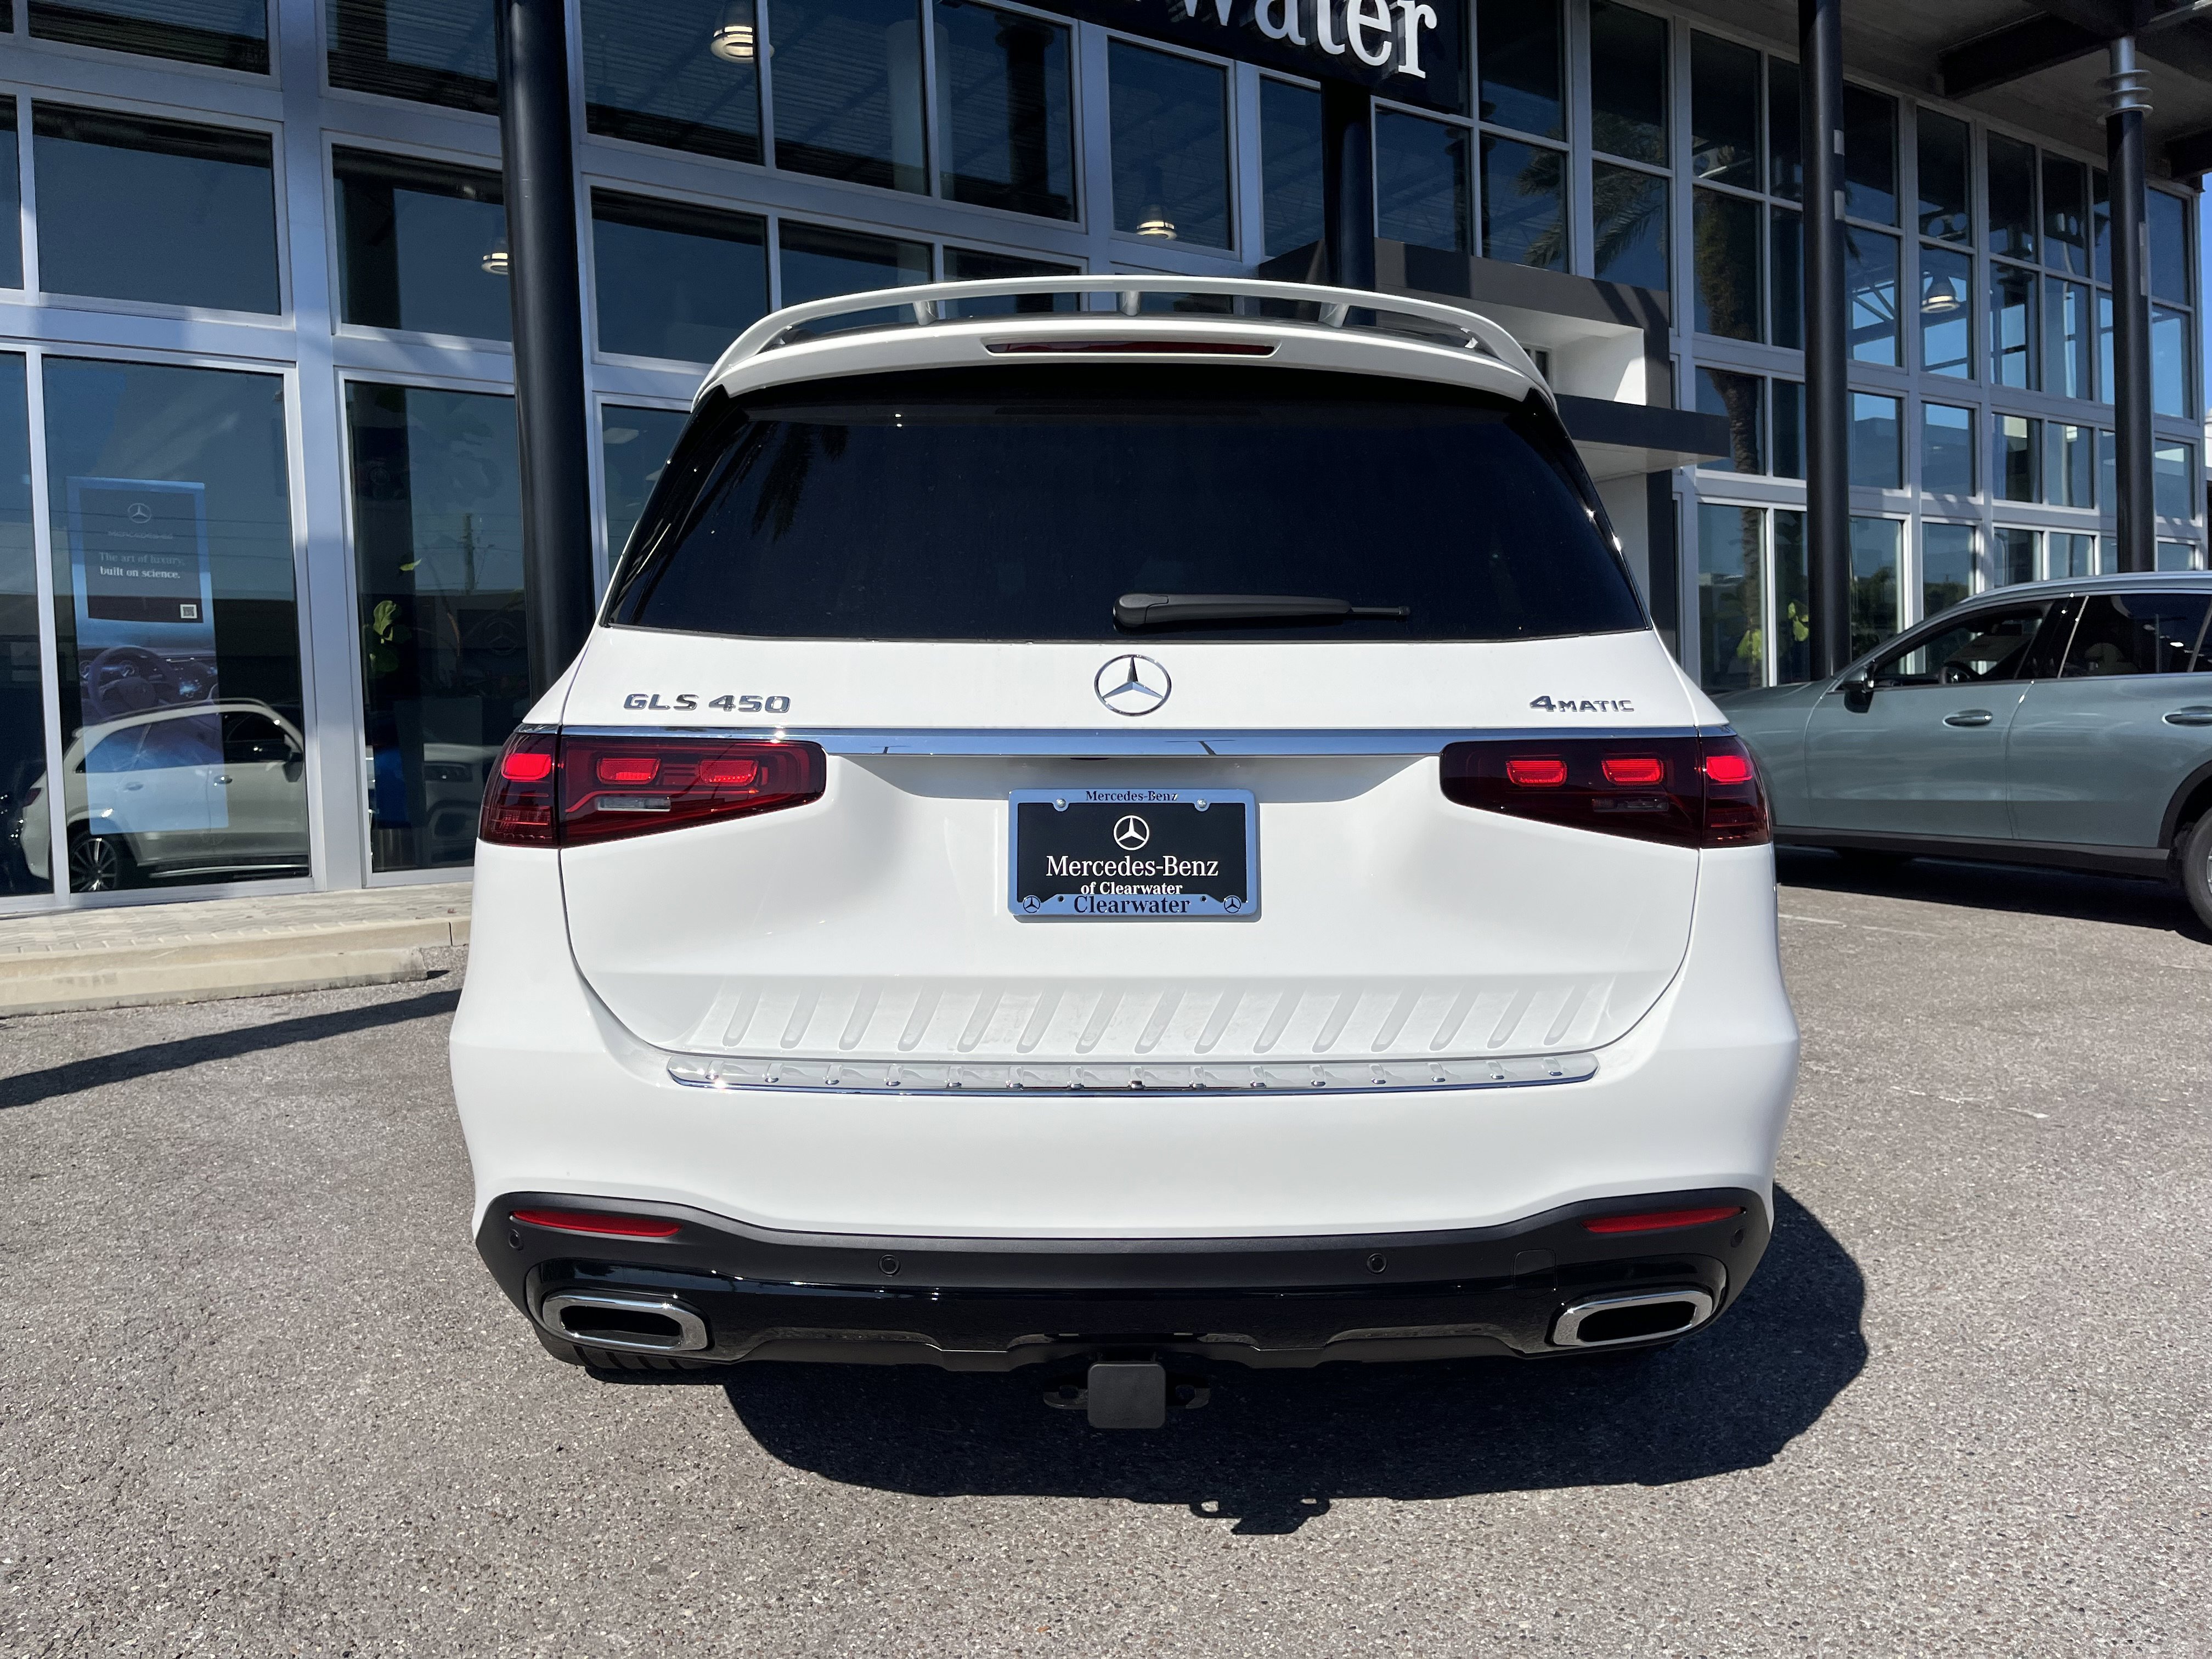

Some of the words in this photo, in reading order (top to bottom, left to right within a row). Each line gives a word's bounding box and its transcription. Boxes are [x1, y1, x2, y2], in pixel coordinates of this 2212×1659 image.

[99, 551, 117, 562] The
[121, 555, 136, 563] art
[138, 554, 148, 563] of
[100, 566, 123, 576] built
[141, 569, 180, 579] science.
[623, 693, 699, 711] GLS
[708, 695, 792, 714] 450
[1529, 695, 1635, 712] 4MATIC
[1086, 790, 1178, 802] Mercedes-Benz
[1045, 855, 1219, 877] Mercedes-Benz
[1080, 881, 1097, 895] of
[1099, 881, 1183, 895] Clearwater
[1073, 895, 1191, 913] Clearwater
